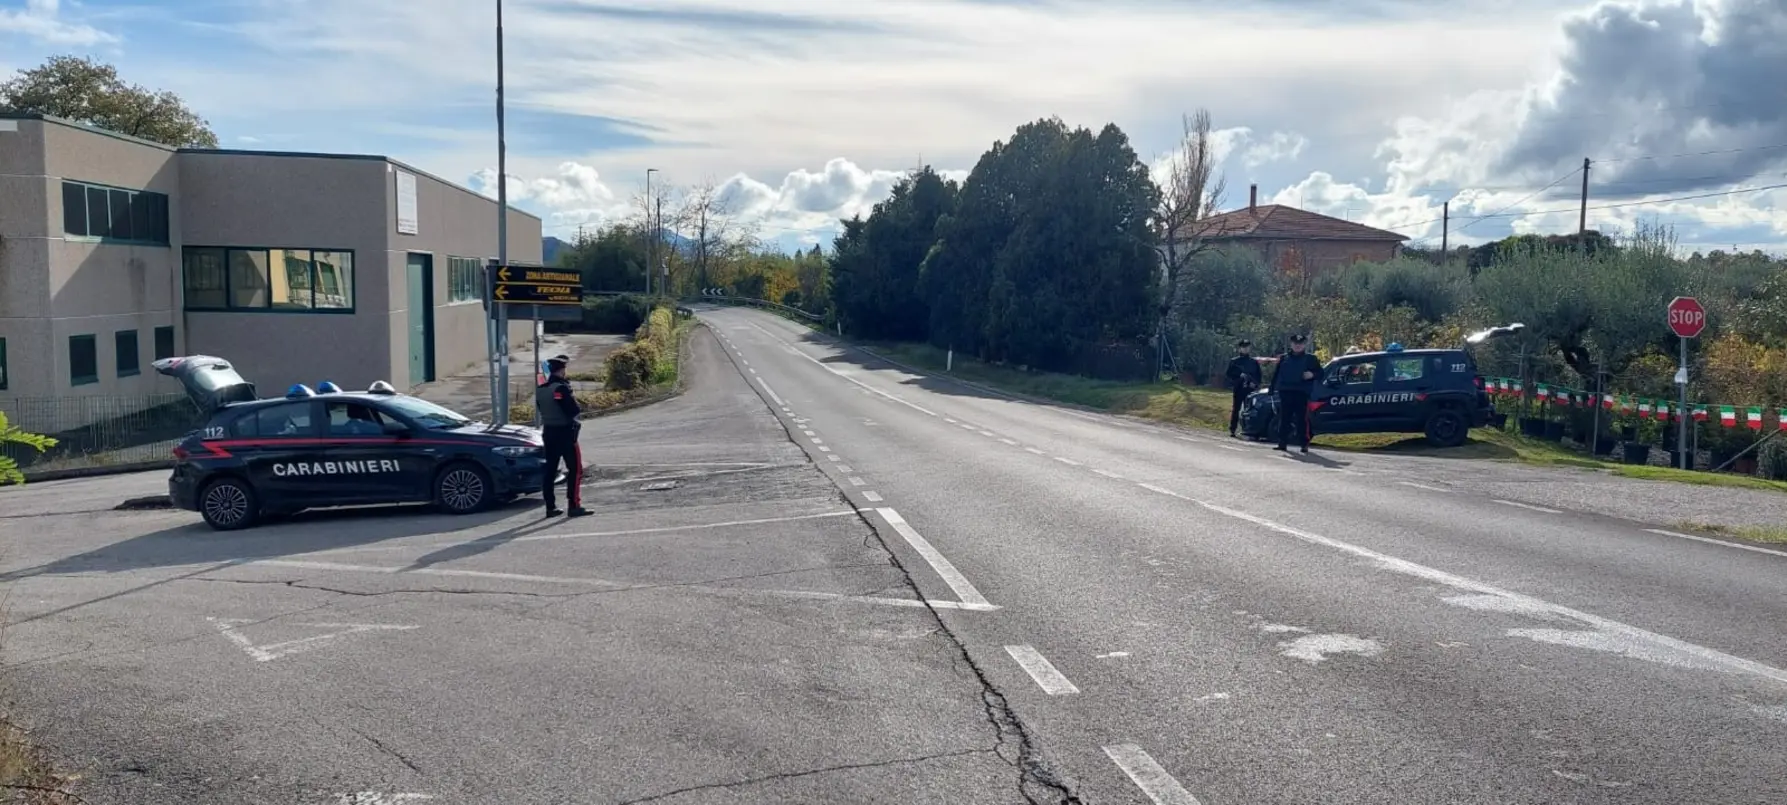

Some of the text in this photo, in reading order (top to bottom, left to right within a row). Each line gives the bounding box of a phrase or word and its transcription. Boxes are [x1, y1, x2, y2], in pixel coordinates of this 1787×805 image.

[1671, 309, 1703, 325] STOP
[1330, 392, 1414, 406] CARABINIERI
[204, 426, 224, 438] 112
[273, 459, 400, 476] CARABINIERI
